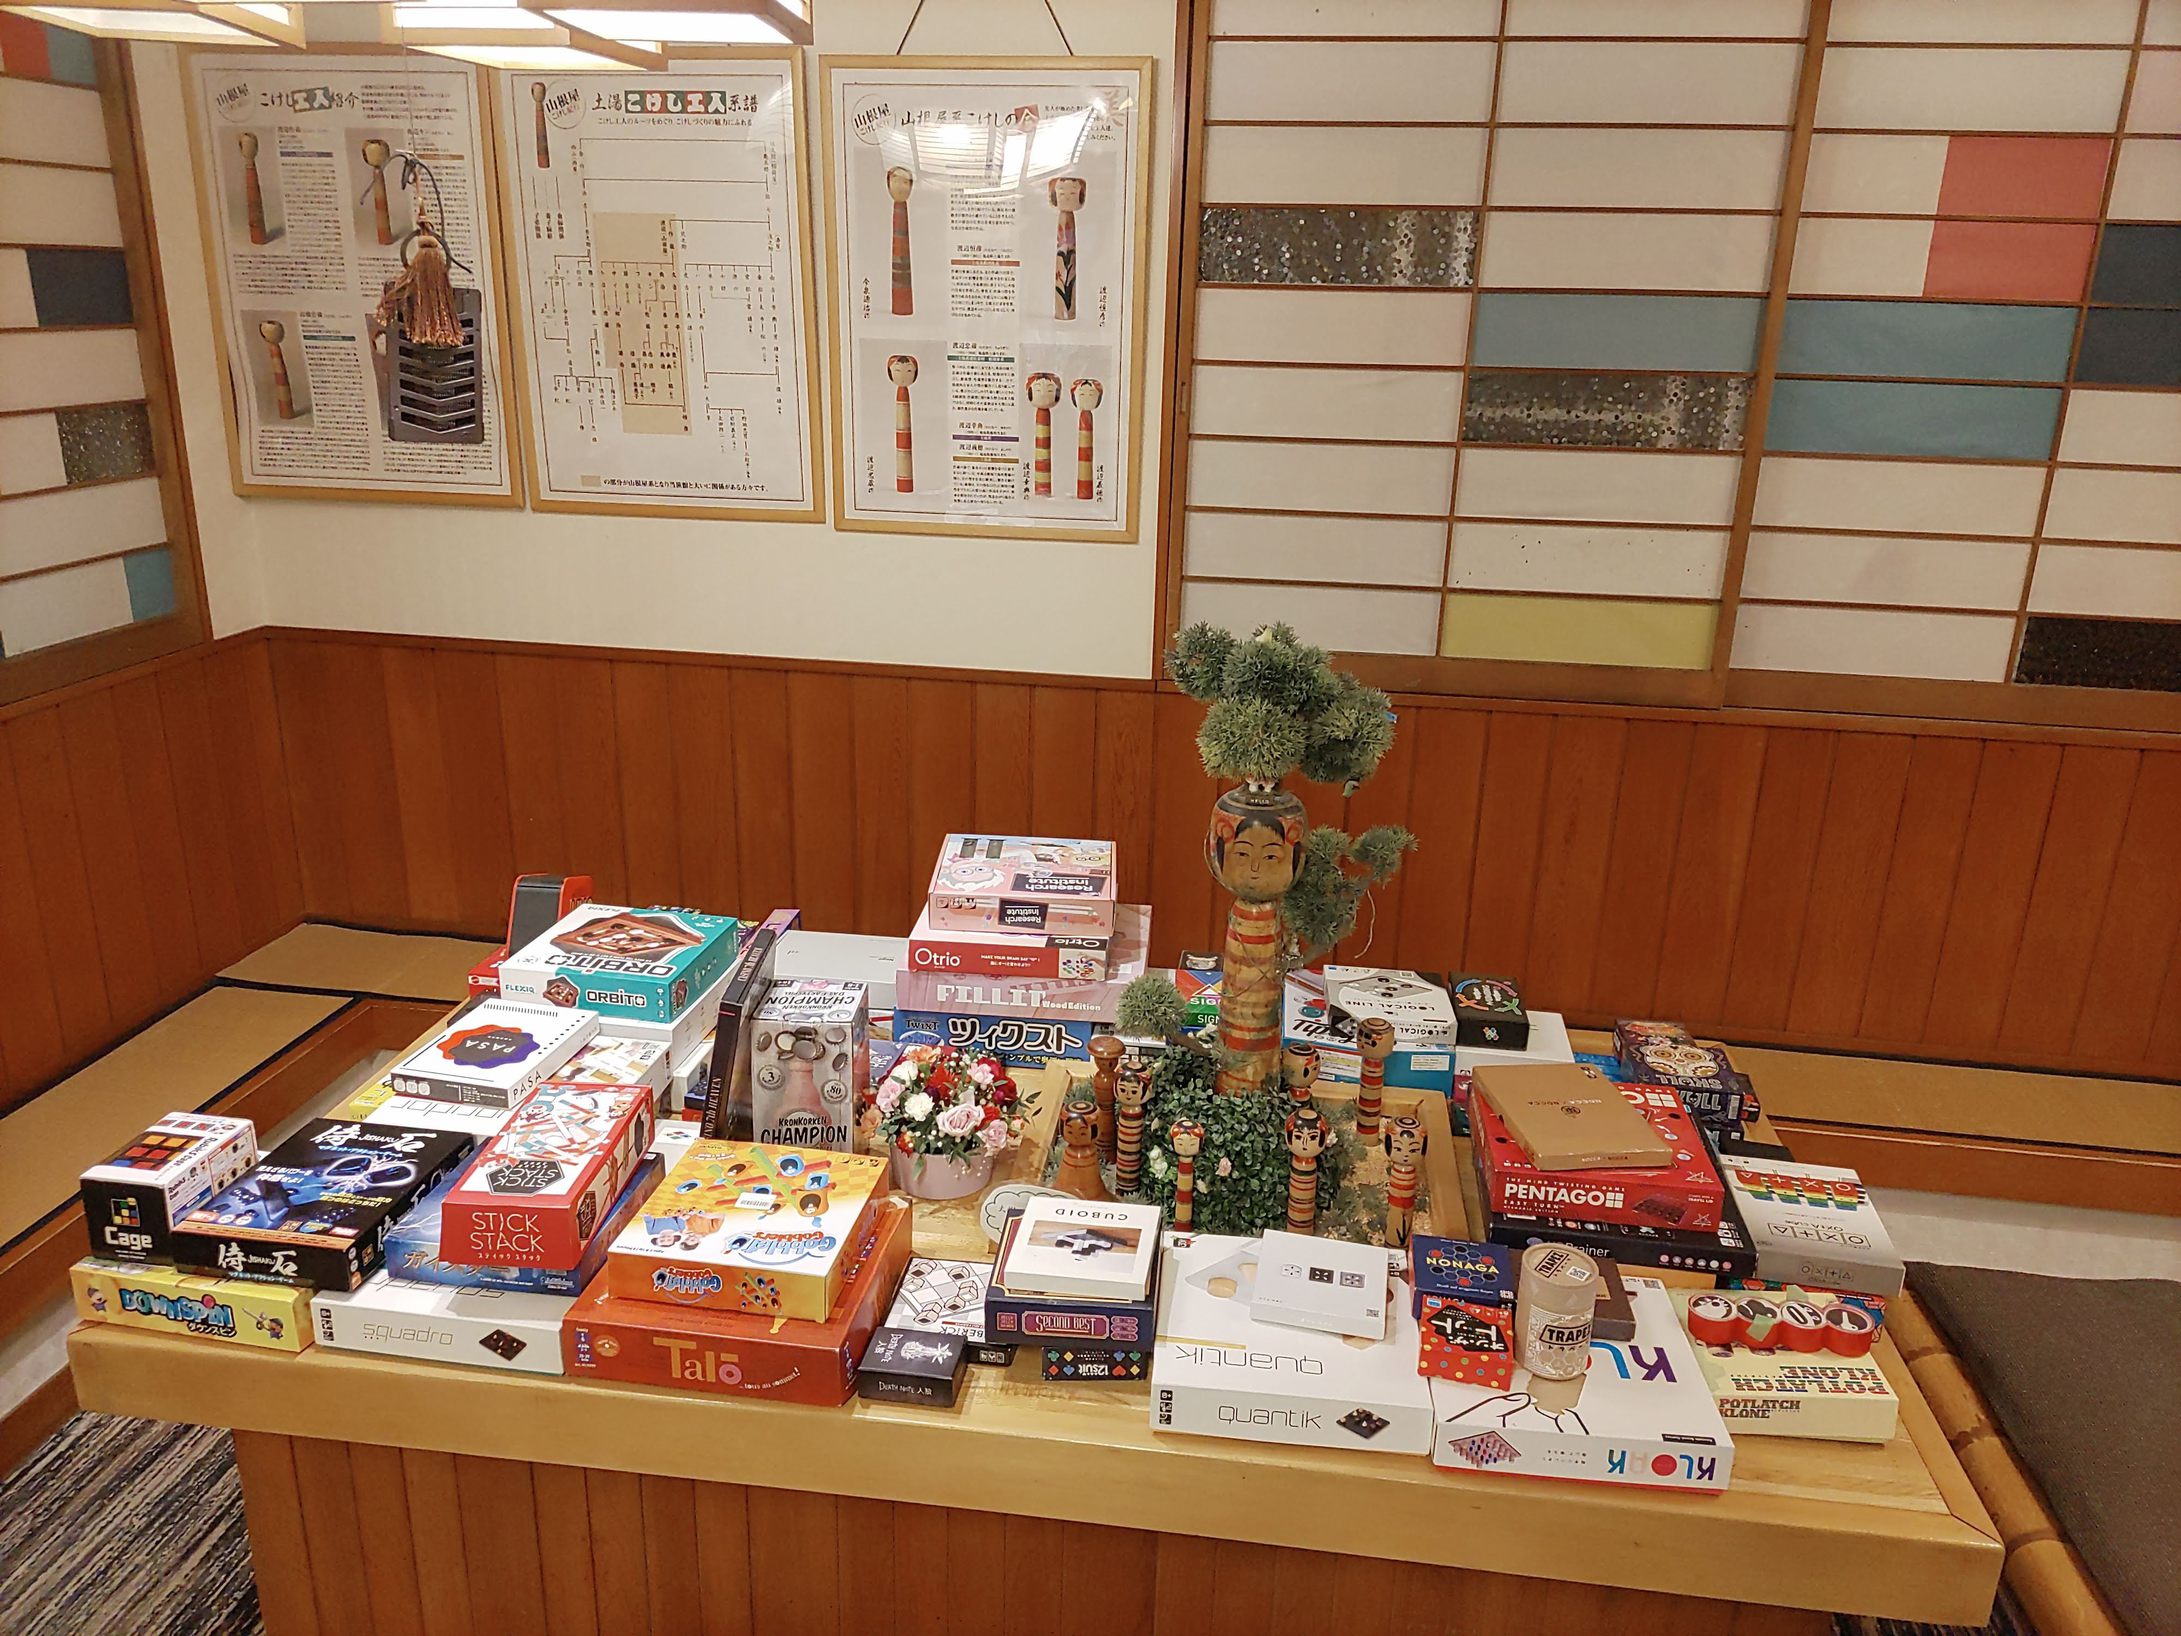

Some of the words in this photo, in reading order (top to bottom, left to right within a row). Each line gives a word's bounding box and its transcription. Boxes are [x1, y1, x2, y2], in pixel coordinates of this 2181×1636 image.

[592, 90, 759, 115] 土湯こけし工人系譜
[1025, 884, 1093, 892] Research
[1028, 877, 1089, 885] Institute
[1006, 908, 1039, 916] Institute
[1005, 916, 1042, 924] Research
[1055, 939, 1100, 947] Otrio
[914, 947, 961, 967] Otrio
[505, 984, 535, 994] FLEXIQ
[937, 984, 1046, 1008] FILLIT
[766, 997, 856, 1005] CHAMPION
[1190, 997, 1221, 1006] SIG
[1379, 1003, 1436, 1011] LOGICAL
[948, 1018, 1083, 1054] ツィクスト
[1399, 1028, 1440, 1037] LOGICAL
[466, 1040, 517, 1053] PASA
[513, 1071, 542, 1101] PASA
[1656, 1074, 1723, 1089] SKULL
[761, 1126, 847, 1145] CHAMPION
[498, 1165, 559, 1178] STACK
[493, 1175, 549, 1187] STICK
[1553, 1181, 1597, 1189] TWISTING
[1504, 1183, 1605, 1206] PENTAGO
[1504, 1199, 1529, 1207] EASY
[471, 1211, 541, 1233] STICK
[1055, 1208, 1128, 1221] CUBOID
[104, 1226, 153, 1251] Cage
[470, 1232, 545, 1253] STACK
[218, 1242, 247, 1272] 侍
[272, 1250, 298, 1277] 石
[1426, 1257, 1499, 1274] NONAGA
[1538, 1252, 1565, 1275] TRAPEZ
[362, 1321, 454, 1346] squadro
[1176, 1345, 1323, 1375] quantik
[1780, 1366, 1882, 1381] KLONE
[1731, 1379, 1890, 1395] POTLATCH
[1718, 1398, 1801, 1410] POTLATCH
[1218, 1405, 1322, 1430] quantik
[1718, 1408, 1771, 1419] KLONE
